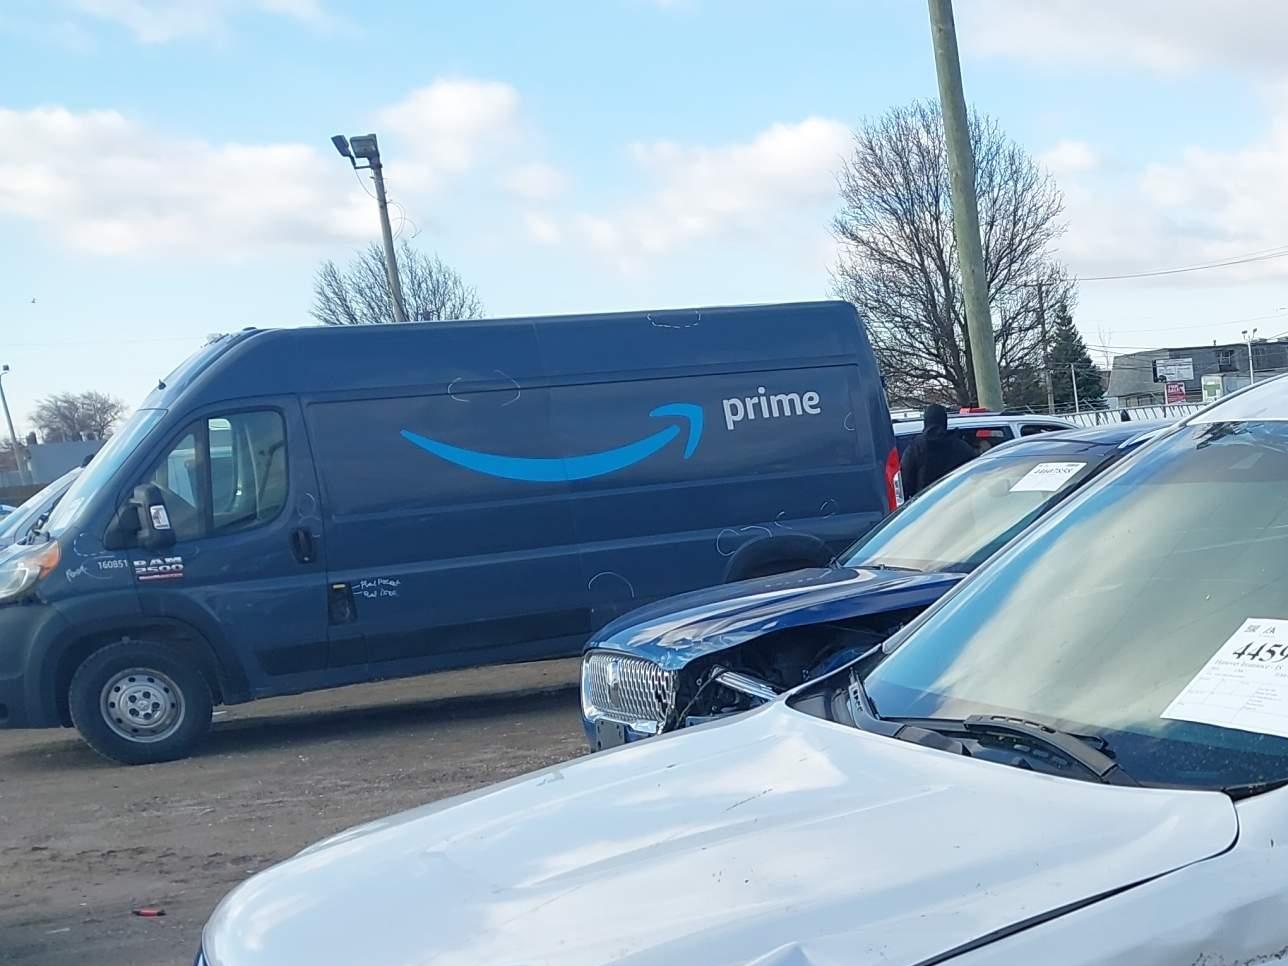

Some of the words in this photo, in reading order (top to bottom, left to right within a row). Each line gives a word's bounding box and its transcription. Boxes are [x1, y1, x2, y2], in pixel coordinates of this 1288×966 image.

[722, 386, 821, 431] prime
[97, 559, 129, 570] 160851
[133, 556, 182, 567] RAM
